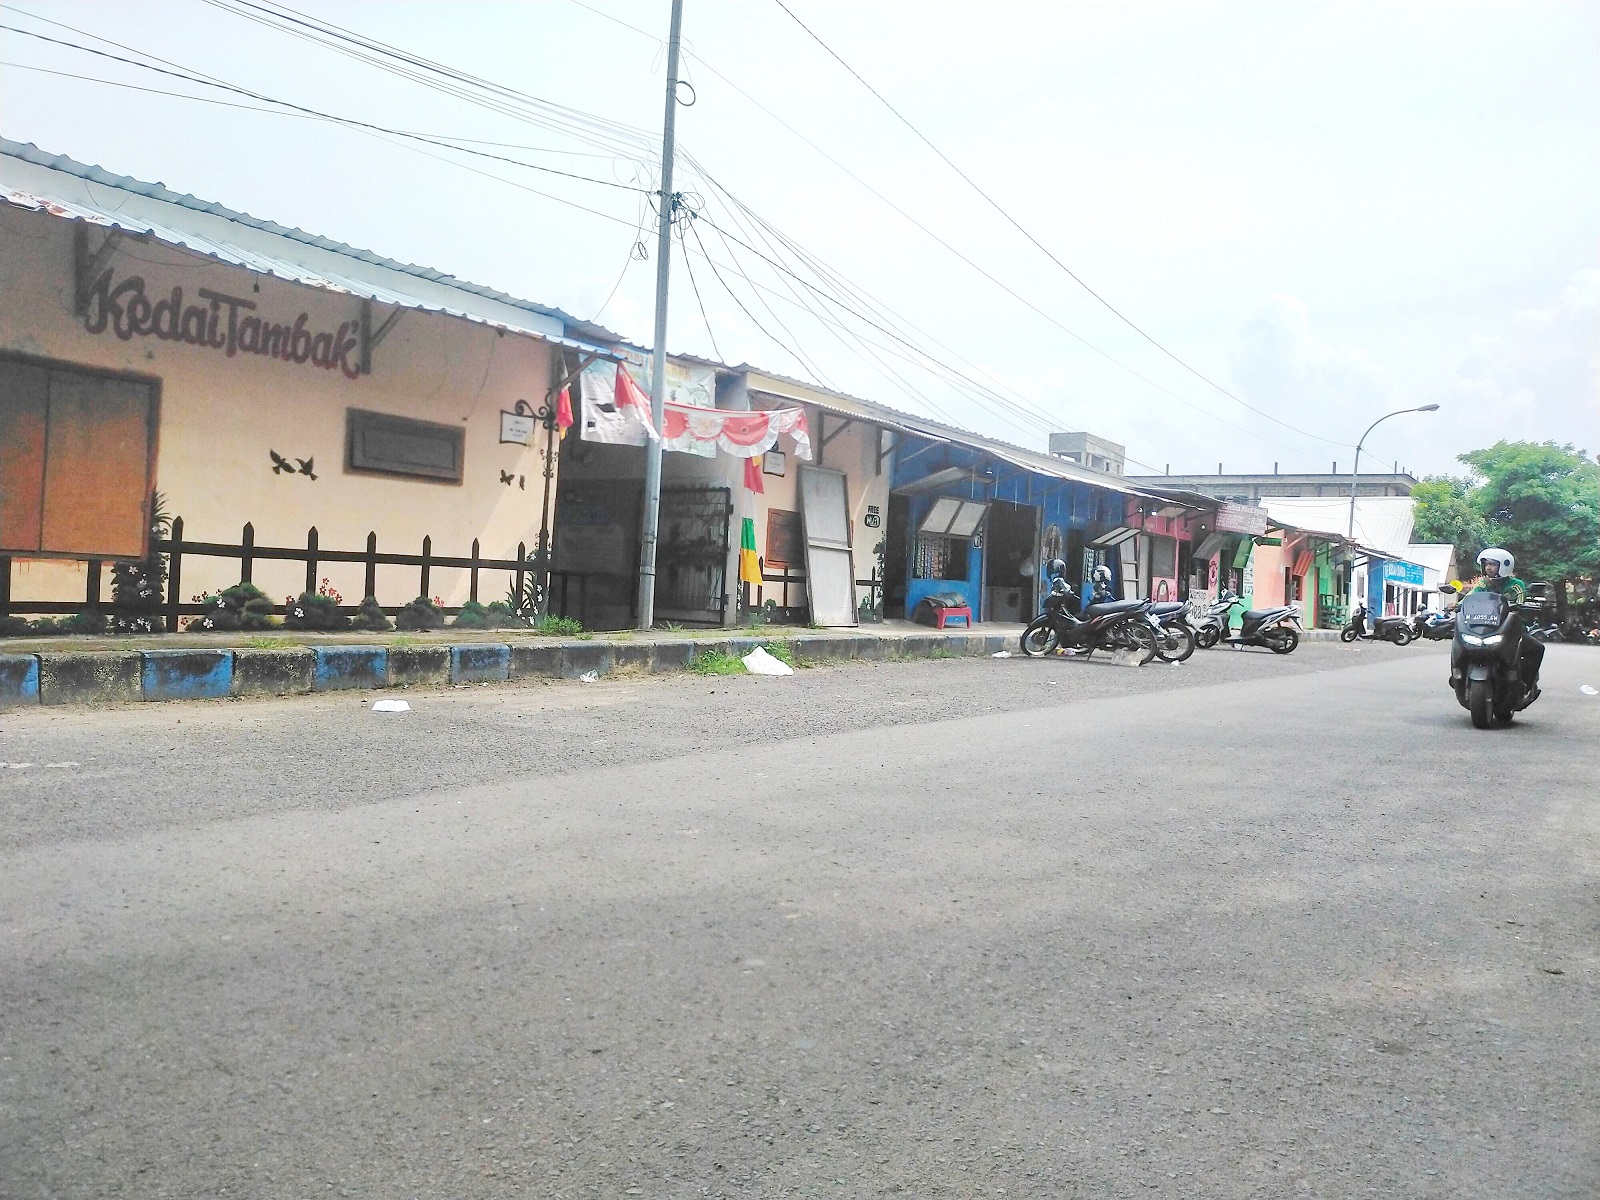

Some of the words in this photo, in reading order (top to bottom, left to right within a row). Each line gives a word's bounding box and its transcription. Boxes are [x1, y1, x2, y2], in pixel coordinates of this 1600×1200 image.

[84, 267, 225, 348] Kedai
[198, 287, 361, 380] Tambak
[867, 504, 880, 514] FREE
